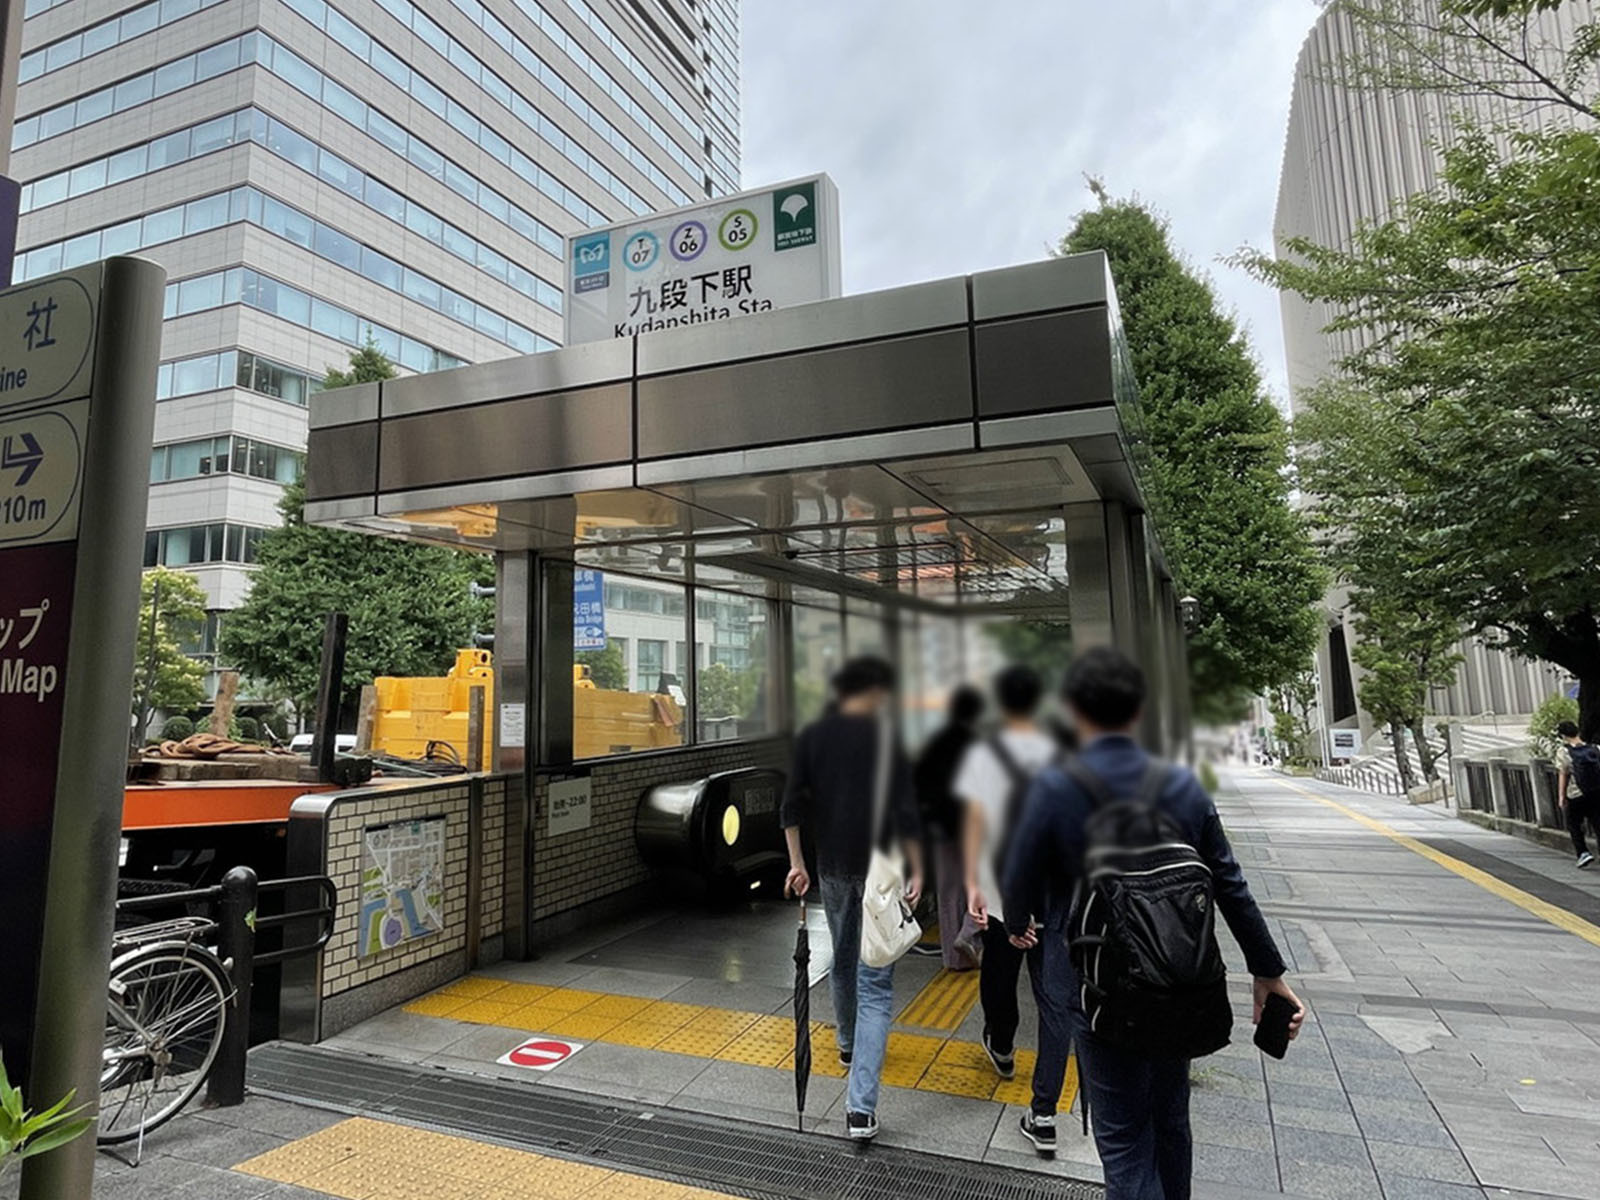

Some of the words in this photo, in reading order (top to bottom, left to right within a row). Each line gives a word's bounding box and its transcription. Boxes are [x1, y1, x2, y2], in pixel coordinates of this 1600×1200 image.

[733, 216, 742, 228] S
[684, 228, 693, 239] Z
[728, 228, 748, 243] 05
[637, 238, 645, 249] T
[679, 240, 698, 254] 06
[632, 249, 650, 264] 07
[629, 264, 753, 317] 九段下駅
[23, 296, 58, 352] 社
[614, 304, 731, 338] Kudanshita
[0, 495, 46, 524] 10m
[0, 658, 57, 703] Map
